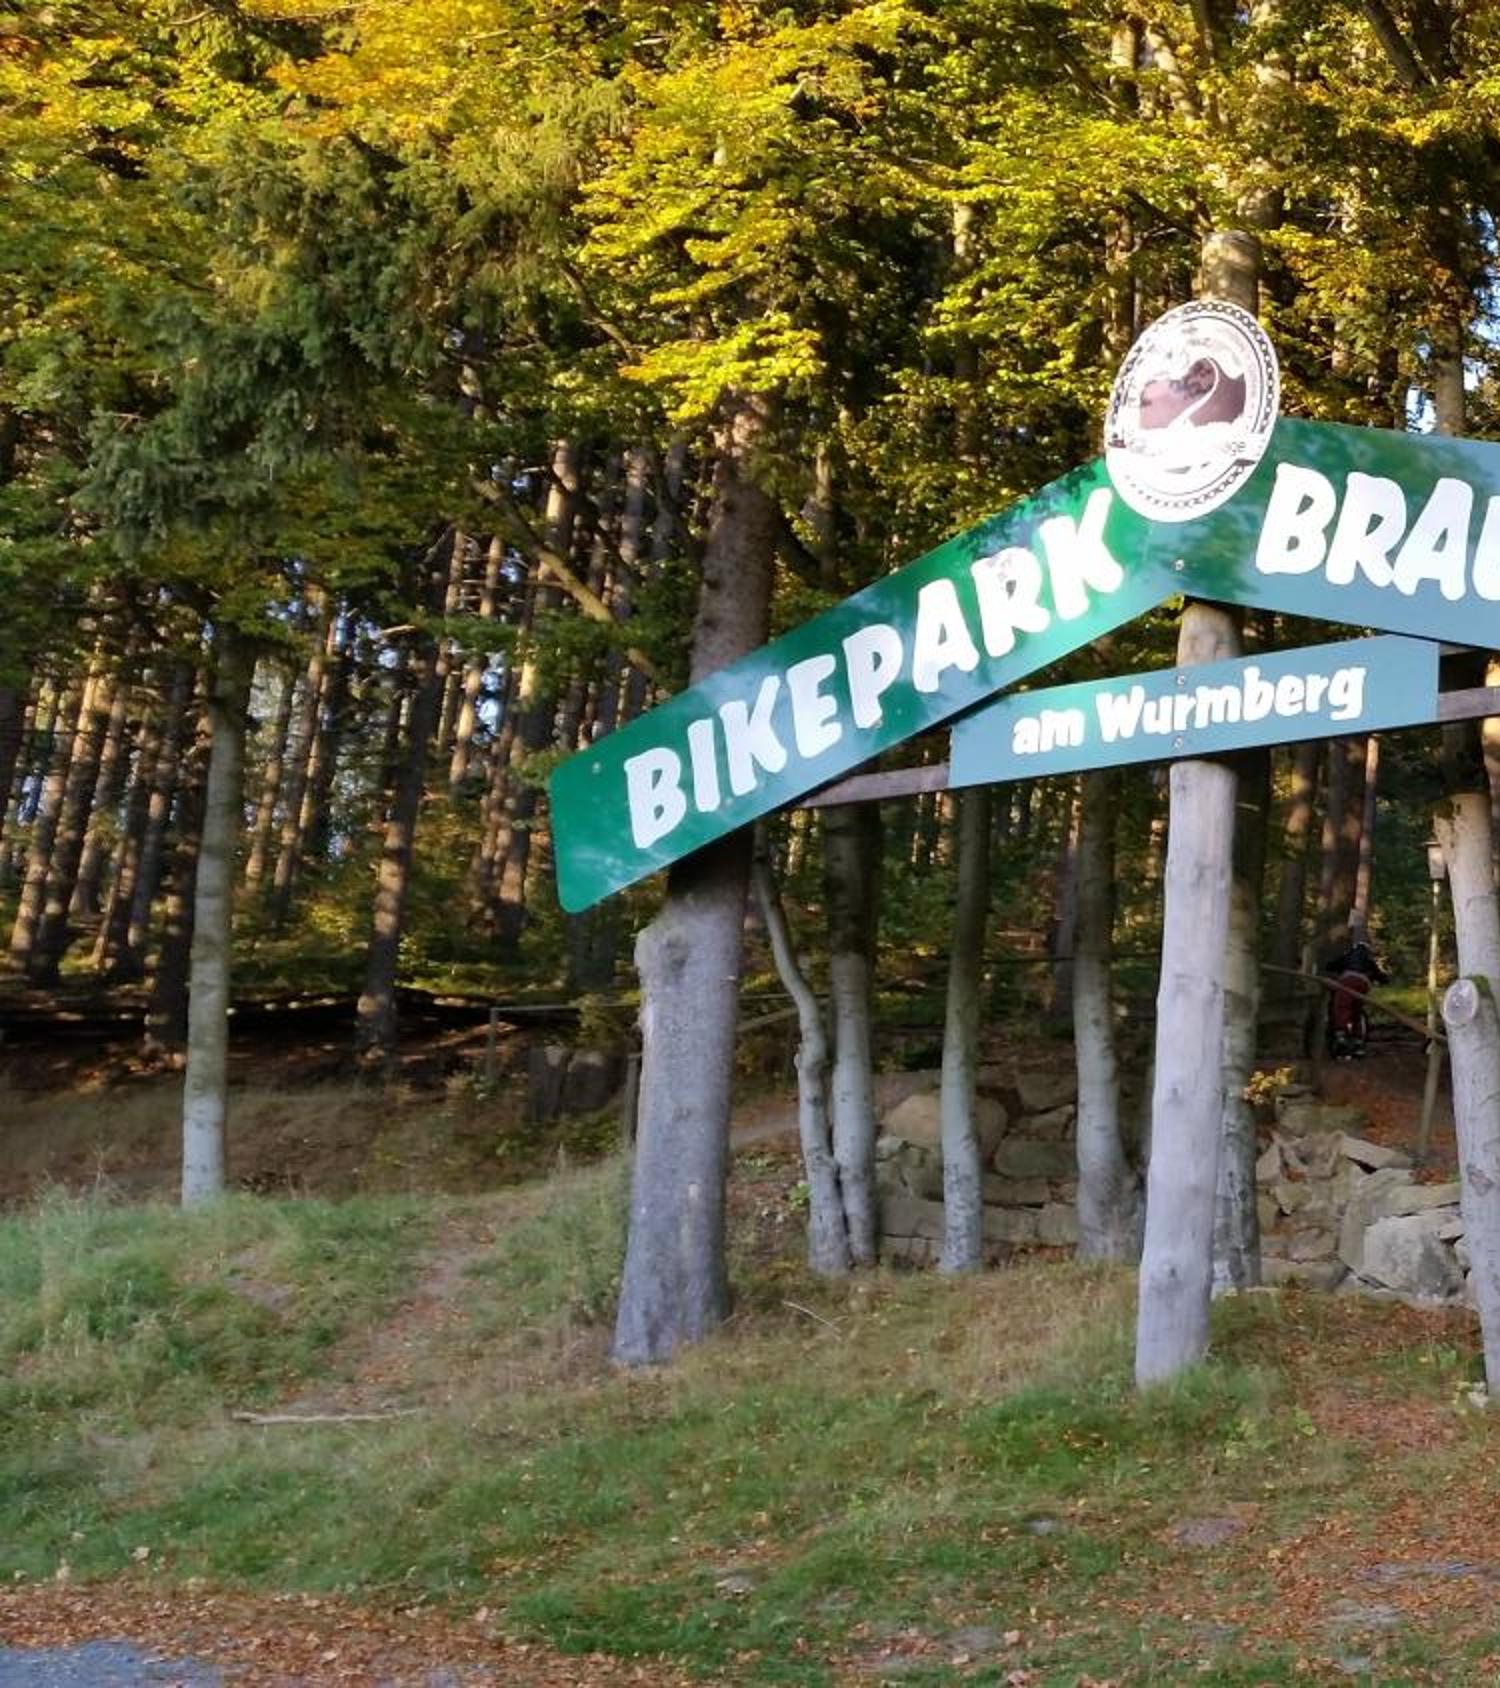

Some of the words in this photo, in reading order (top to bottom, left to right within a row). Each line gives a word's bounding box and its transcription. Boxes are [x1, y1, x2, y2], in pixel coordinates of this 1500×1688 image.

[624, 487, 1124, 849] BIKEPARK
[1012, 708, 1085, 755] am
[1095, 666, 1367, 743] Wurmberg
